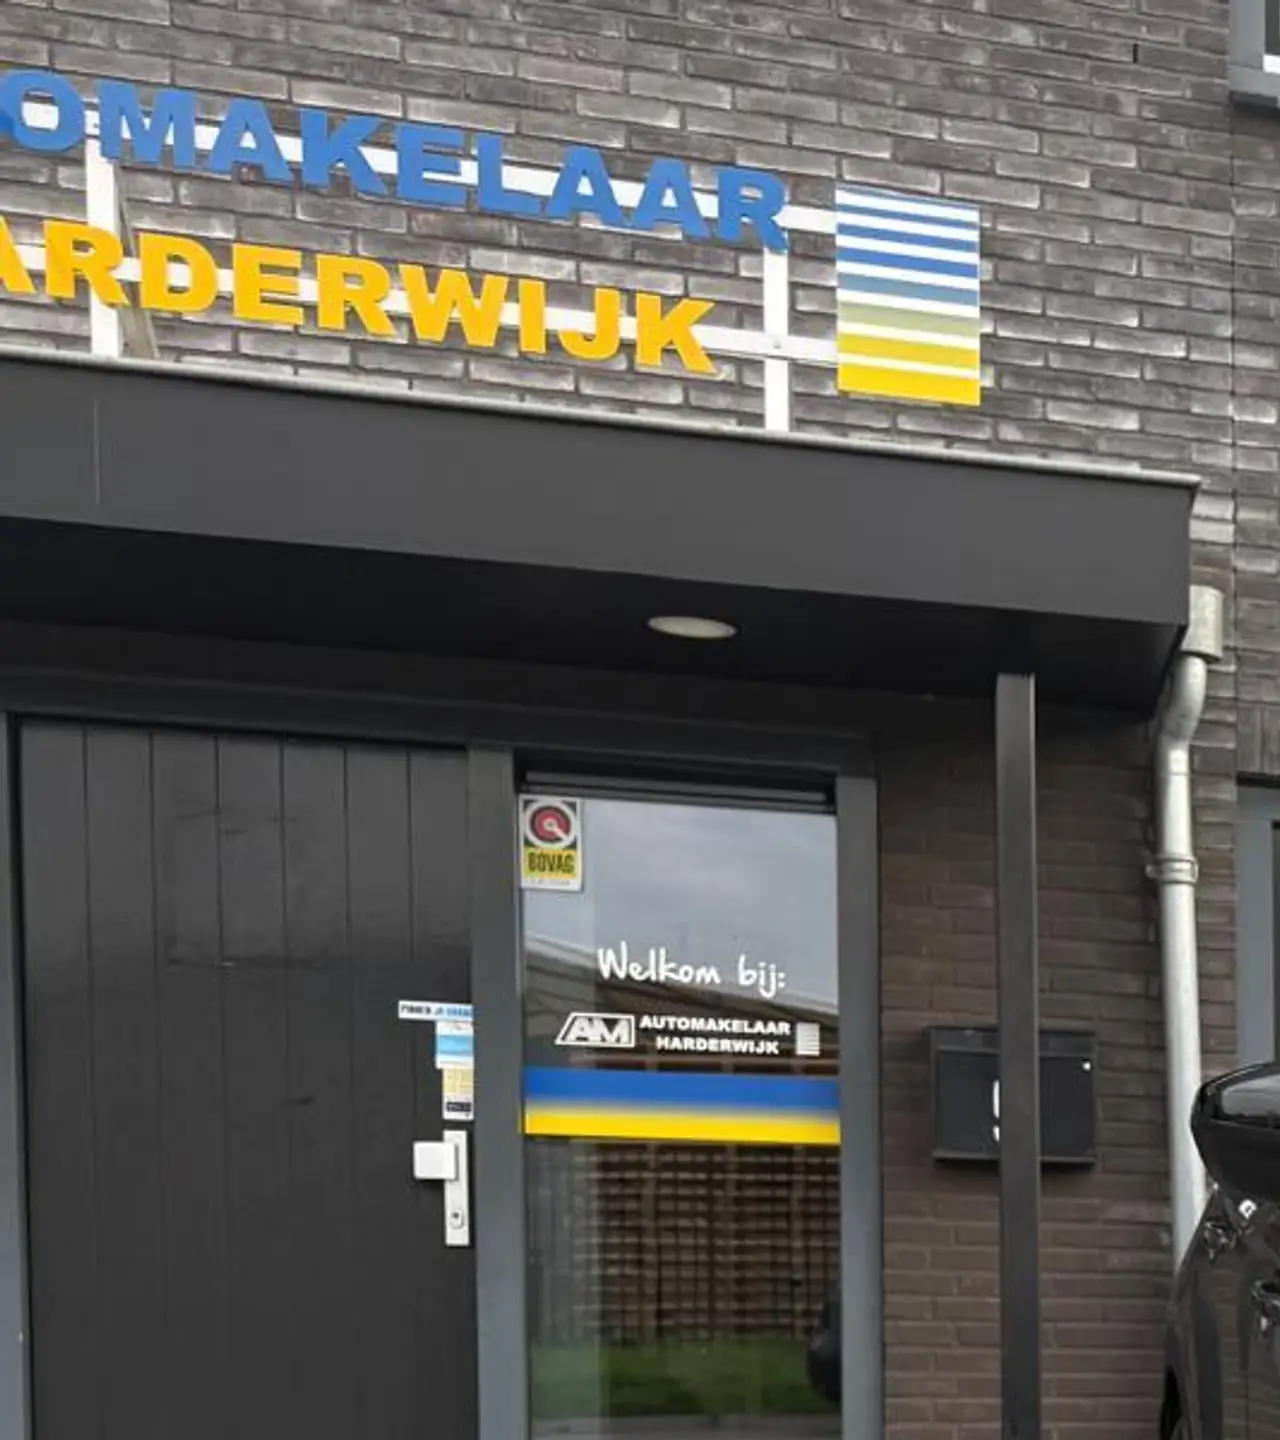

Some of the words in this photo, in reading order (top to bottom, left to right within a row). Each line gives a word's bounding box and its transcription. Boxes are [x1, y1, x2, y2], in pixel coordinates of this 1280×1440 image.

[0, 68, 790, 251] OMAKELAAR
[598, 940, 721, 983] Welkom
[738, 953, 786, 998] bij:
[640, 1015, 791, 1035] AUTOMAKELAAR
[656, 1036, 779, 1055] HARDERWIJK
